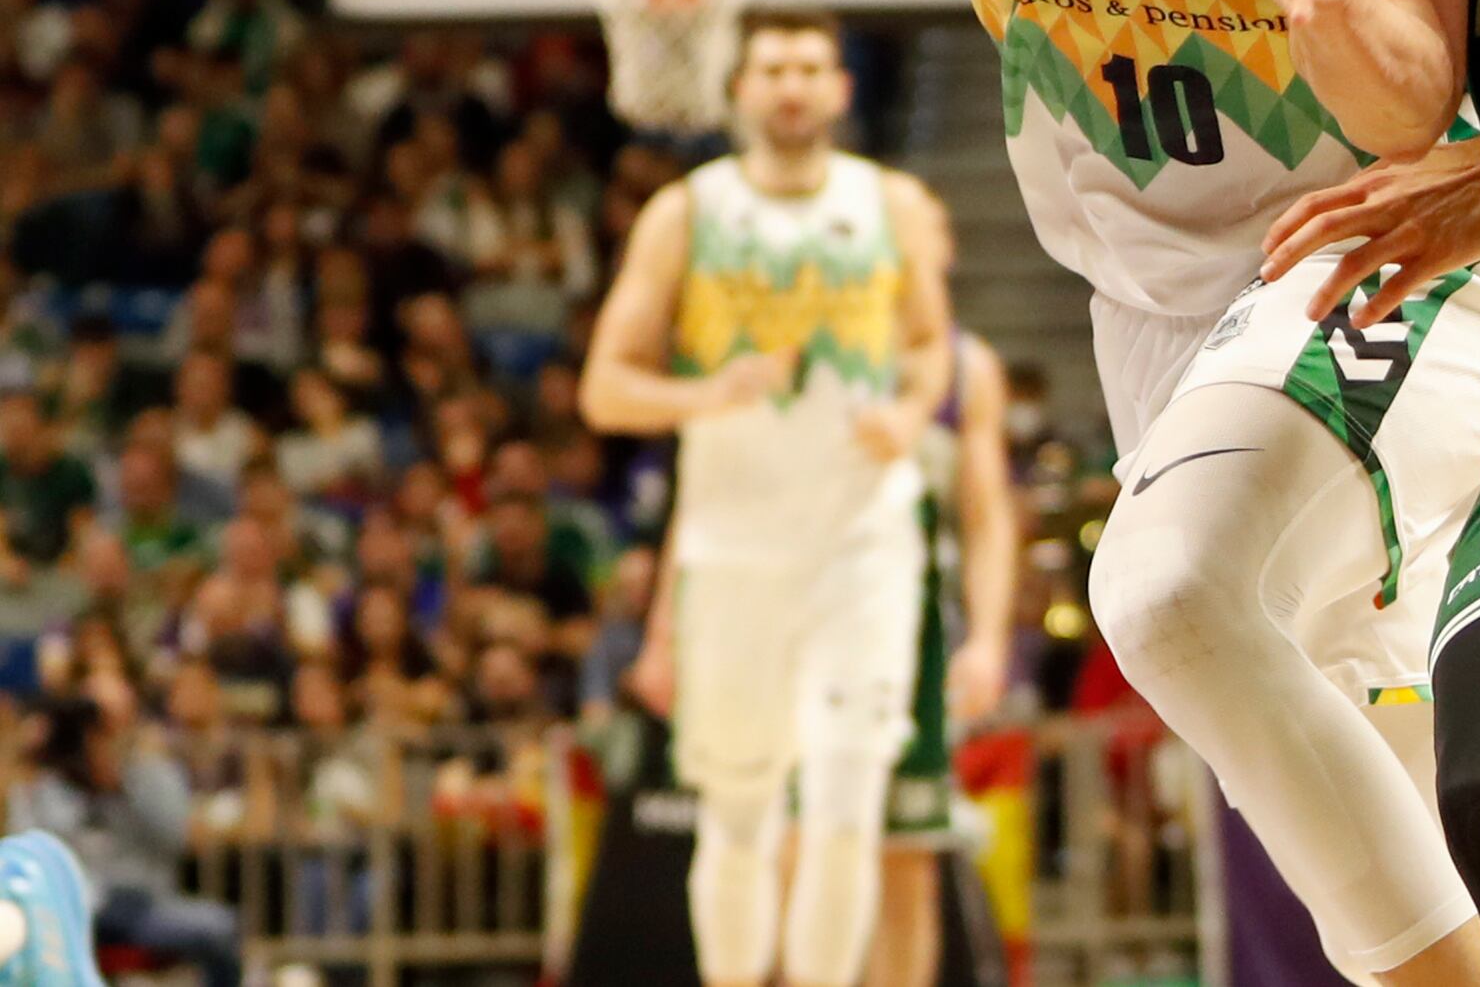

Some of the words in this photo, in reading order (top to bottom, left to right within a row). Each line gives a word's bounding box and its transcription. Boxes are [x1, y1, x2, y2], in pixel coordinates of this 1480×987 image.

[1106, 0, 1129, 17] &
[1141, 4, 1289, 32] pensio
[1102, 54, 1224, 166] 10
